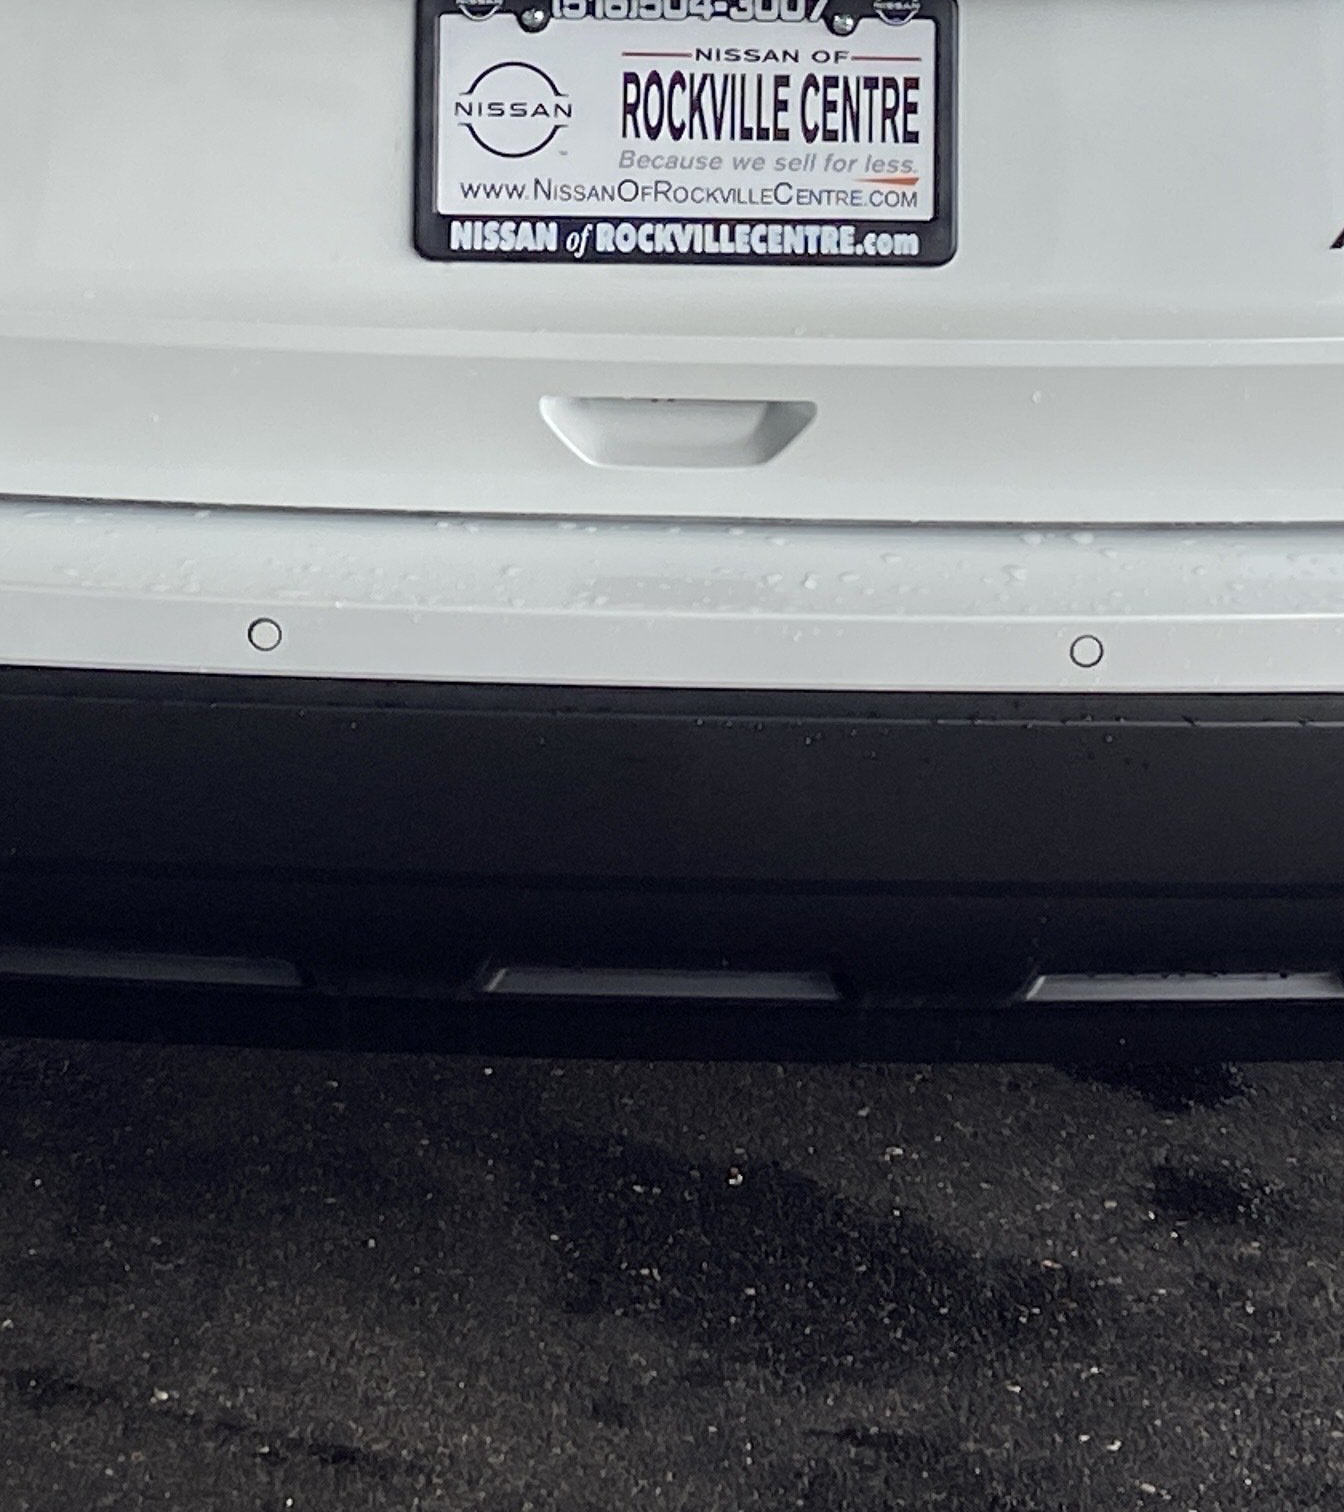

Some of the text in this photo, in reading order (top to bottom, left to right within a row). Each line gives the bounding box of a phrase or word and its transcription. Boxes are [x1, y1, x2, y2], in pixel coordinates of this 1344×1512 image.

[695, 47, 850, 64] NISSAN OF
[454, 101, 572, 119] NISSAN
[621, 70, 921, 144] ROCKVILLE CENTRE
[618, 149, 919, 175] Because we sell for less.
[450, 220, 919, 259] NISSAN of ROCKVILLECENTRE.com
